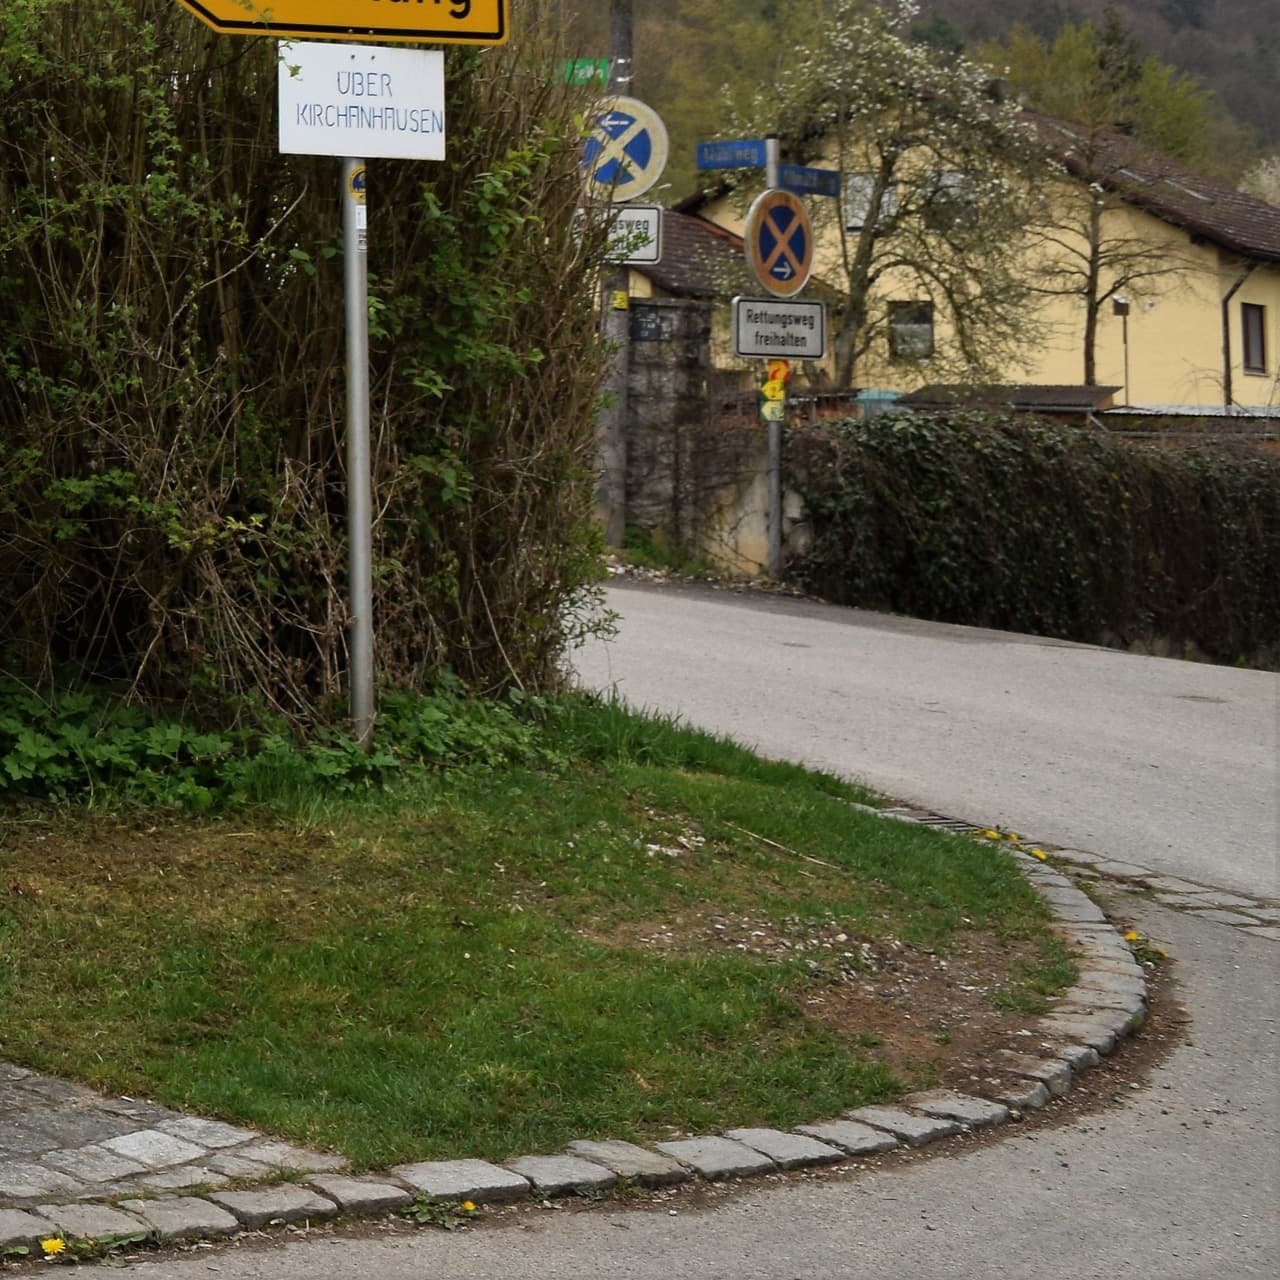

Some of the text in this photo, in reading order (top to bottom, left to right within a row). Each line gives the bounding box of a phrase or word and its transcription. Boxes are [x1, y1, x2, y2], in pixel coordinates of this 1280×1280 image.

[336, 70, 393, 97] ÜBER
[295, 102, 444, 134] KIRCHANHAUSEN
[746, 308, 815, 330] Rettungsweg
[755, 331, 808, 348] freihalten
